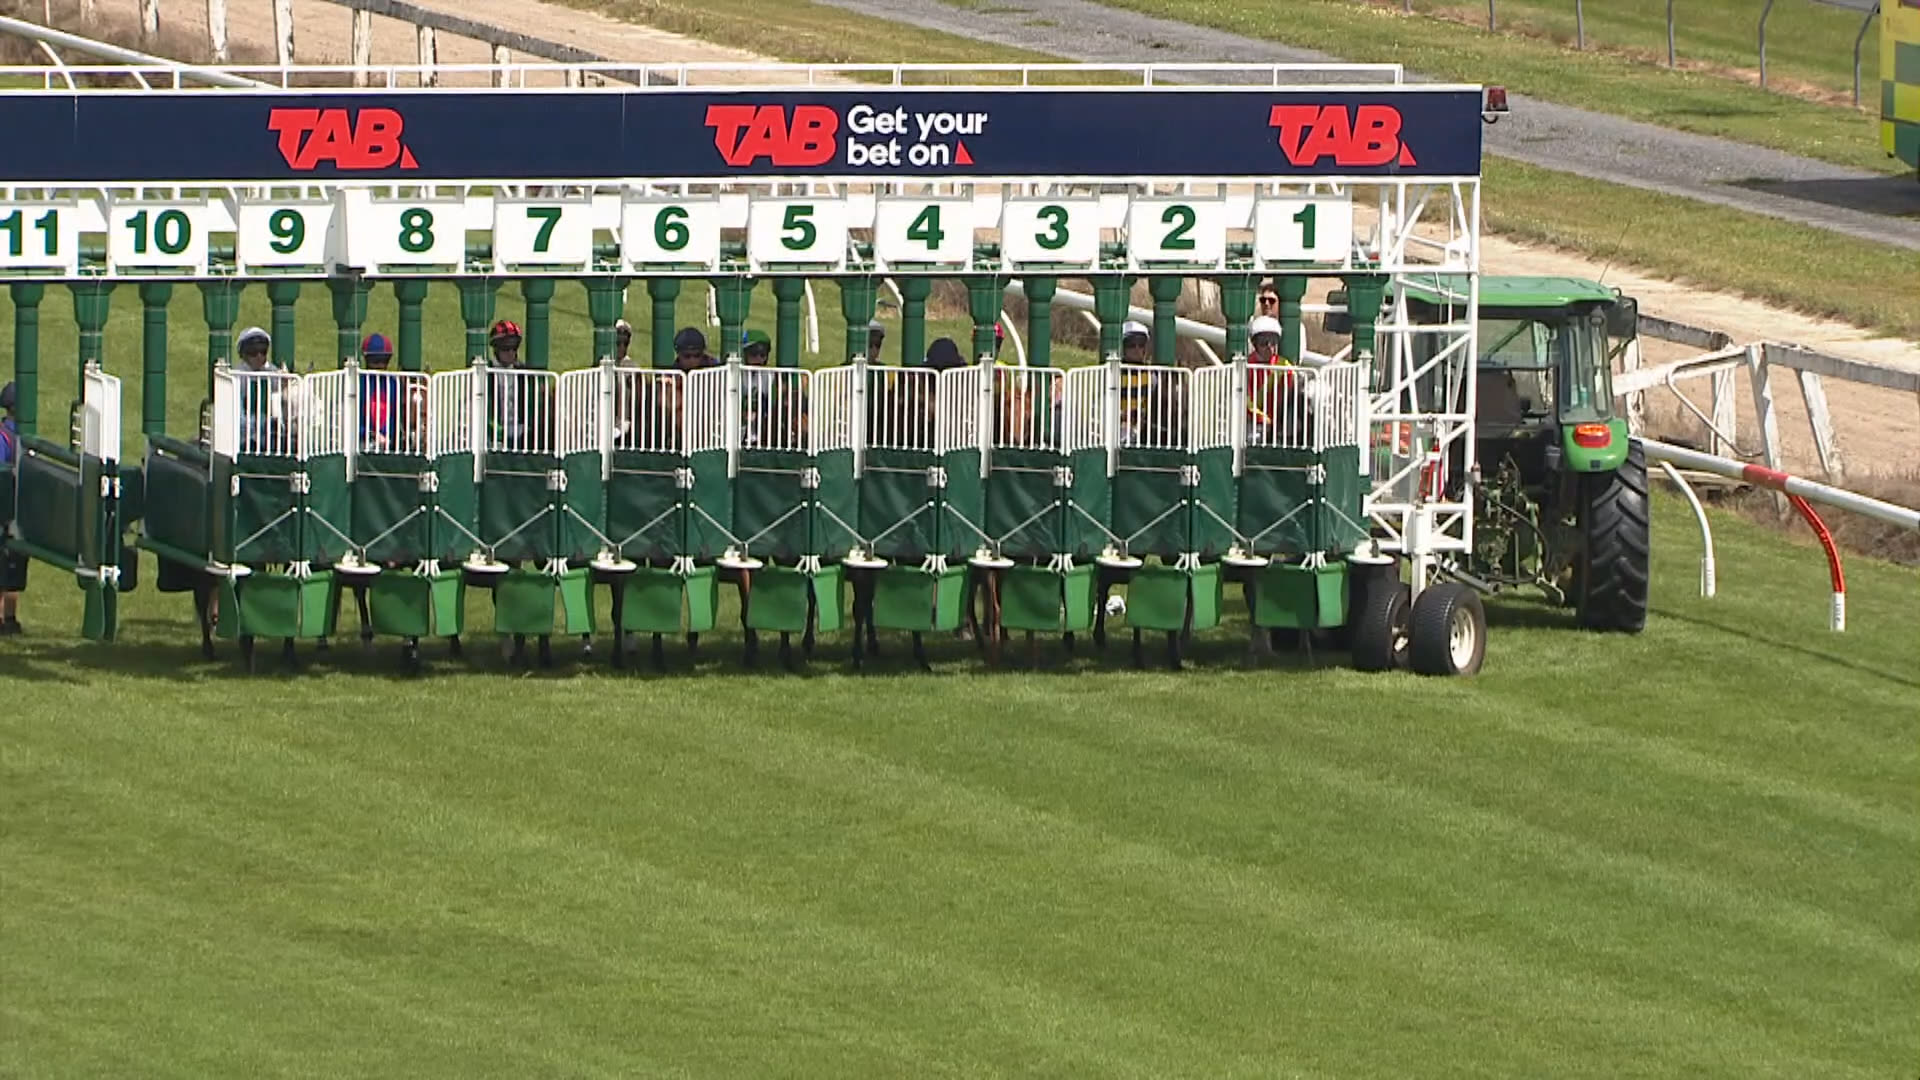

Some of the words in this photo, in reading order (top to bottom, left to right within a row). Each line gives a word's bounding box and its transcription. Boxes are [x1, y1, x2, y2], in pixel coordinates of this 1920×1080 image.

[269, 108, 404, 170] TAB
[704, 105, 839, 166] TAB
[847, 104, 908, 135] Get
[914, 112, 988, 142] your
[1268, 104, 1403, 166] TAB
[847, 136, 902, 166] bet
[908, 143, 950, 167] on
[0, 209, 58, 257] 11
[125, 209, 192, 255] 10
[268, 208, 305, 254] 9
[398, 207, 435, 253] 8
[526, 206, 562, 253] 7
[654, 205, 690, 252] 6
[780, 205, 817, 251] 5
[906, 204, 945, 250] 4
[1034, 205, 1070, 250] 3
[1160, 204, 1196, 250] 2
[1293, 203, 1316, 249] 1
